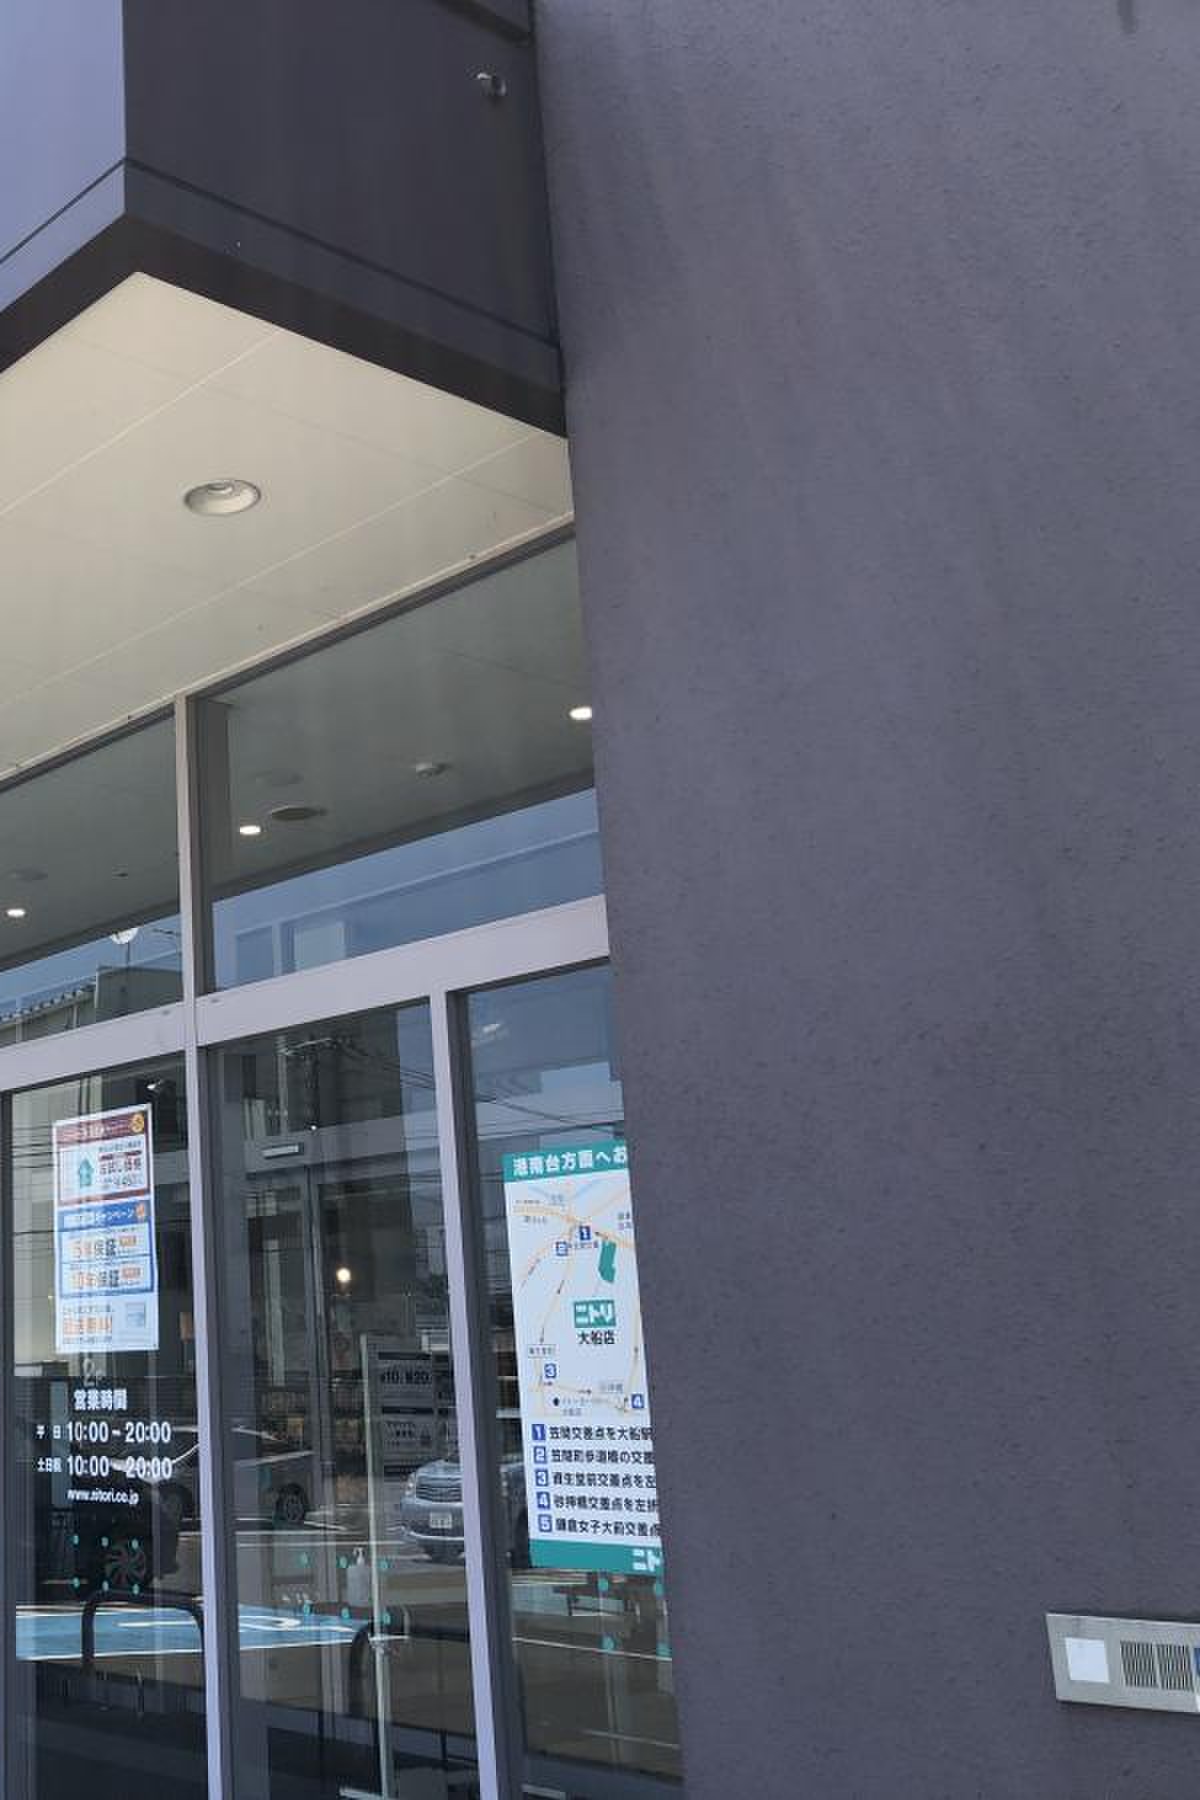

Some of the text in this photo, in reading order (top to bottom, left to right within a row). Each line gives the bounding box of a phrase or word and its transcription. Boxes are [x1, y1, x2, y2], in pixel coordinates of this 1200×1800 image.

[575, 1303, 615, 1325] ニトリ
[577, 1330, 615, 1345] 大船店
[74, 1388, 128, 1411] 営業時間
